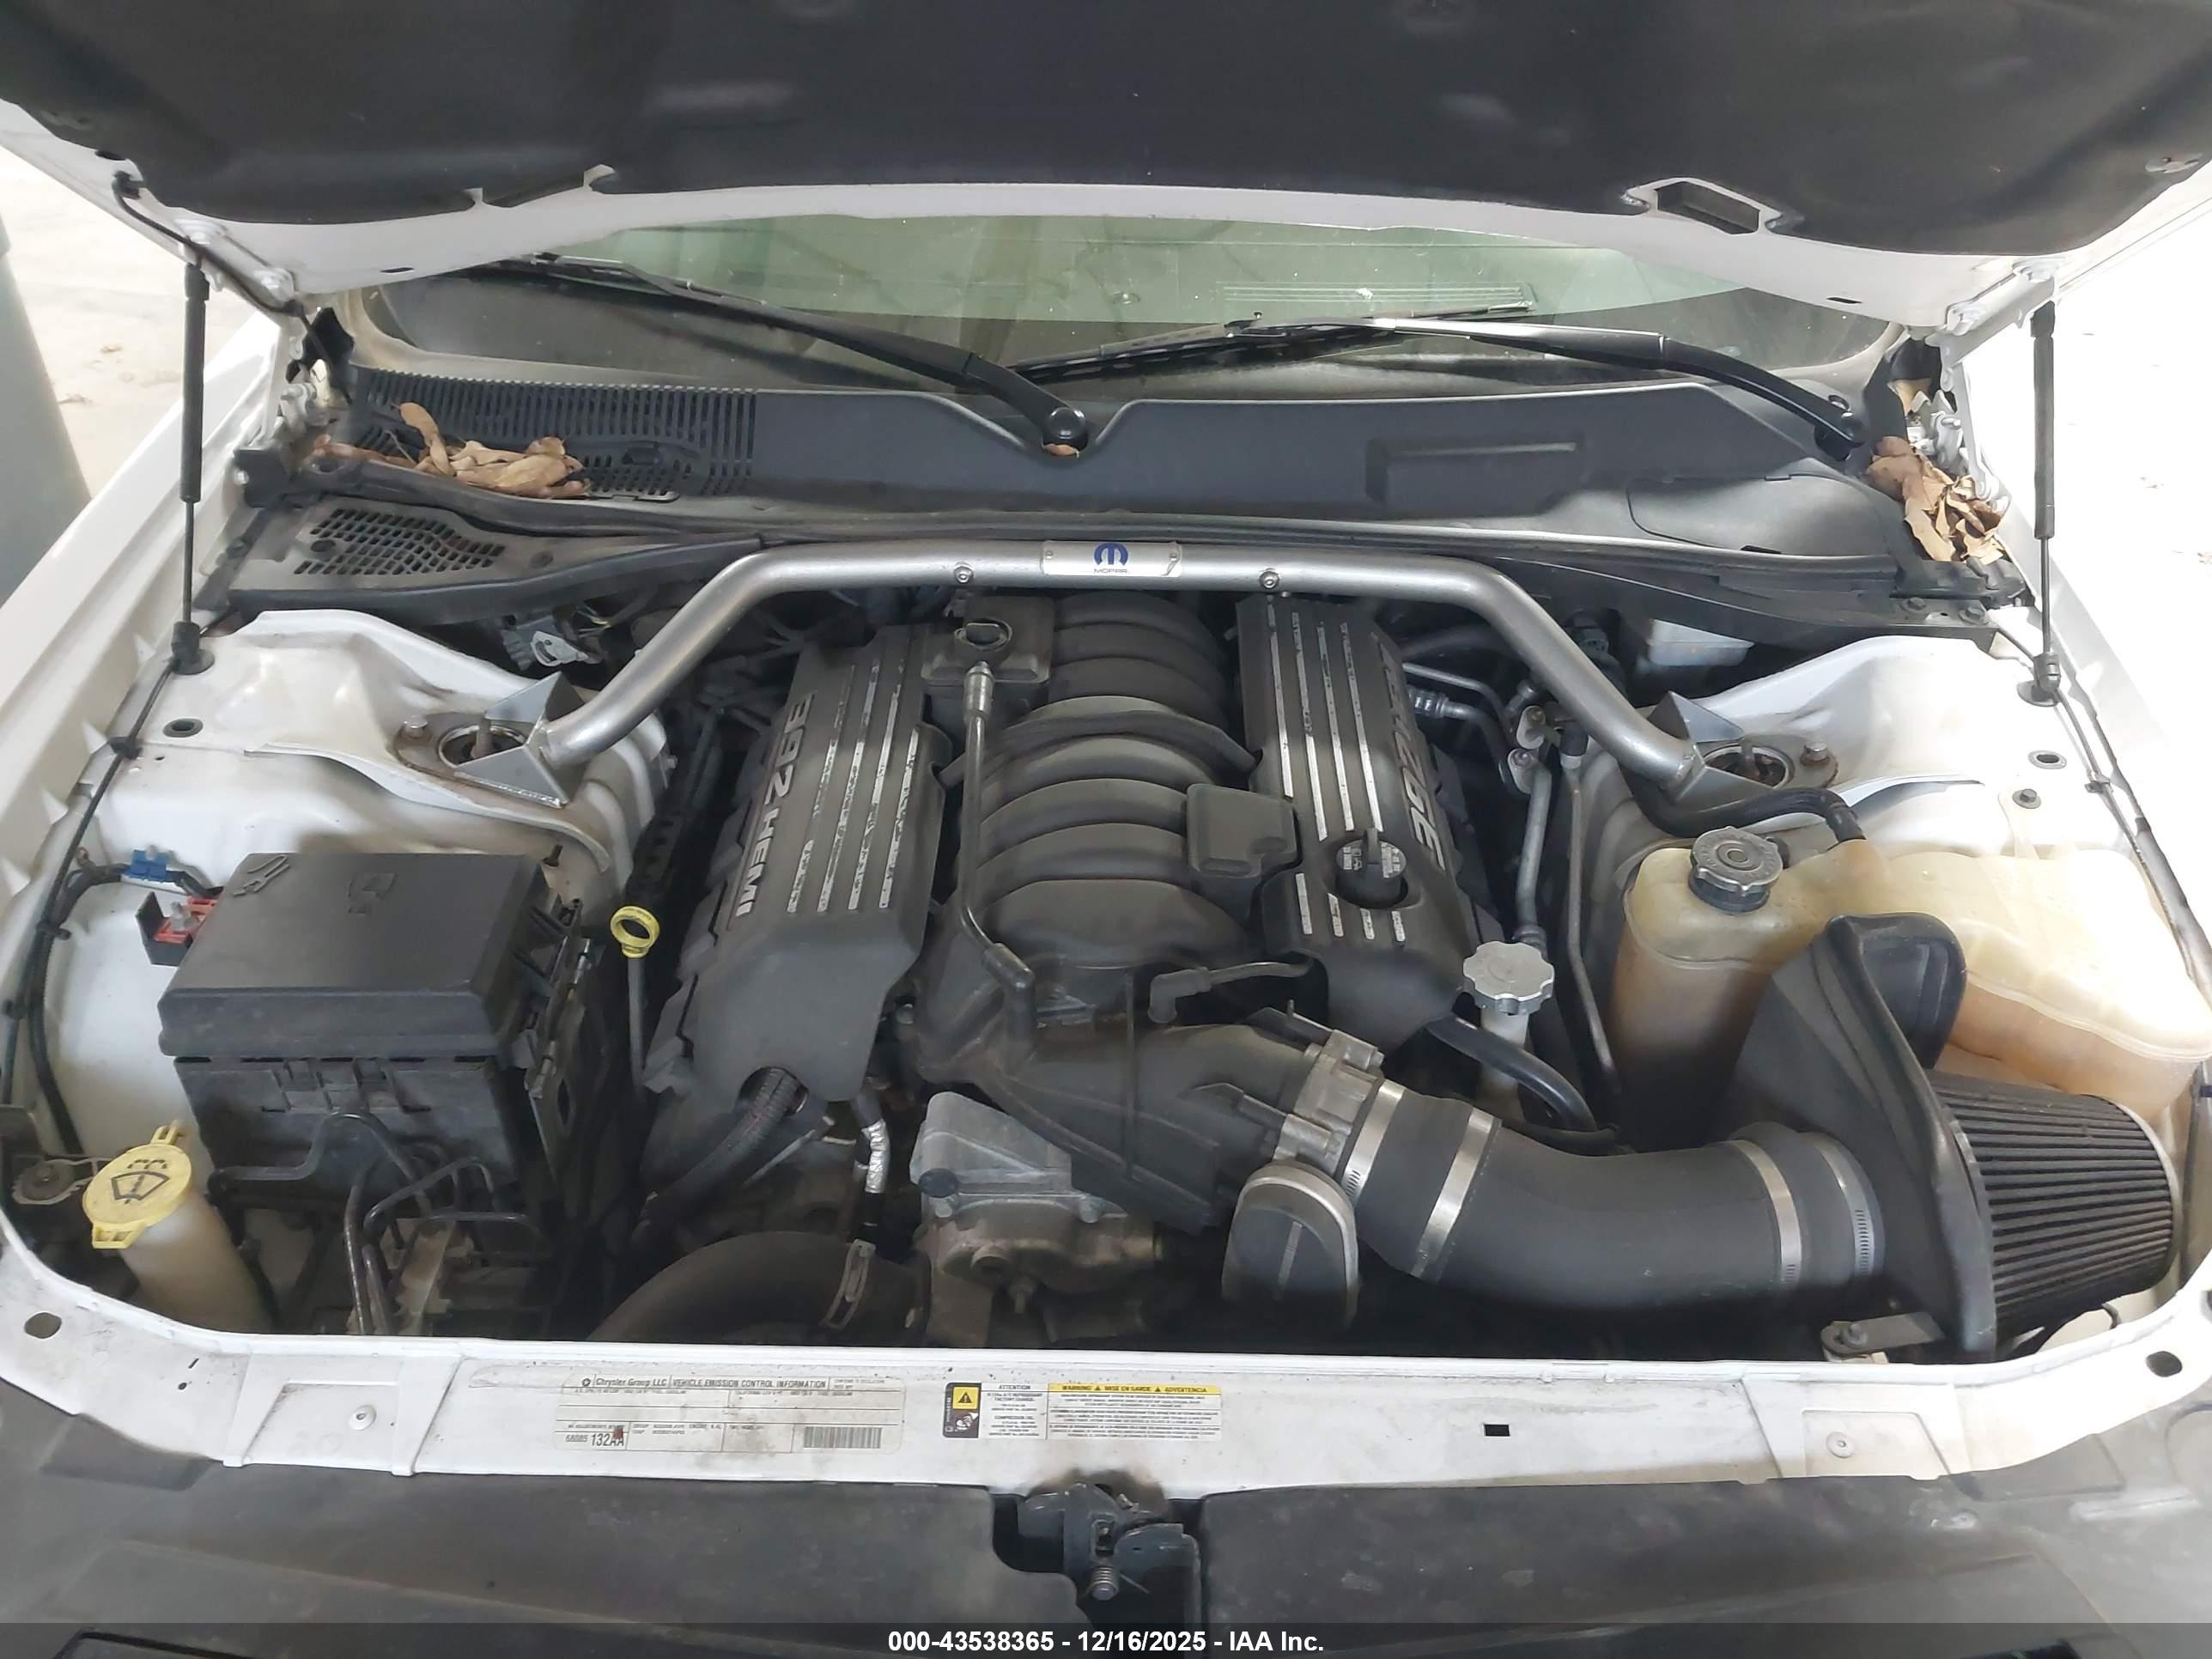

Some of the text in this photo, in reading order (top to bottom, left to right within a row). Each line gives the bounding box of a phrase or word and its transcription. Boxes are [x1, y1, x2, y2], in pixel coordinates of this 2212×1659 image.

[735, 693, 815, 917] 392 HEMI
[596, 1378, 626, 1387] Chrysler
[628, 1378, 651, 1388] Group
[672, 1378, 703, 1387] VEHICLE
[704, 1379, 738, 1388] EMISSION
[776, 1380, 826, 1389] INFORMATION
